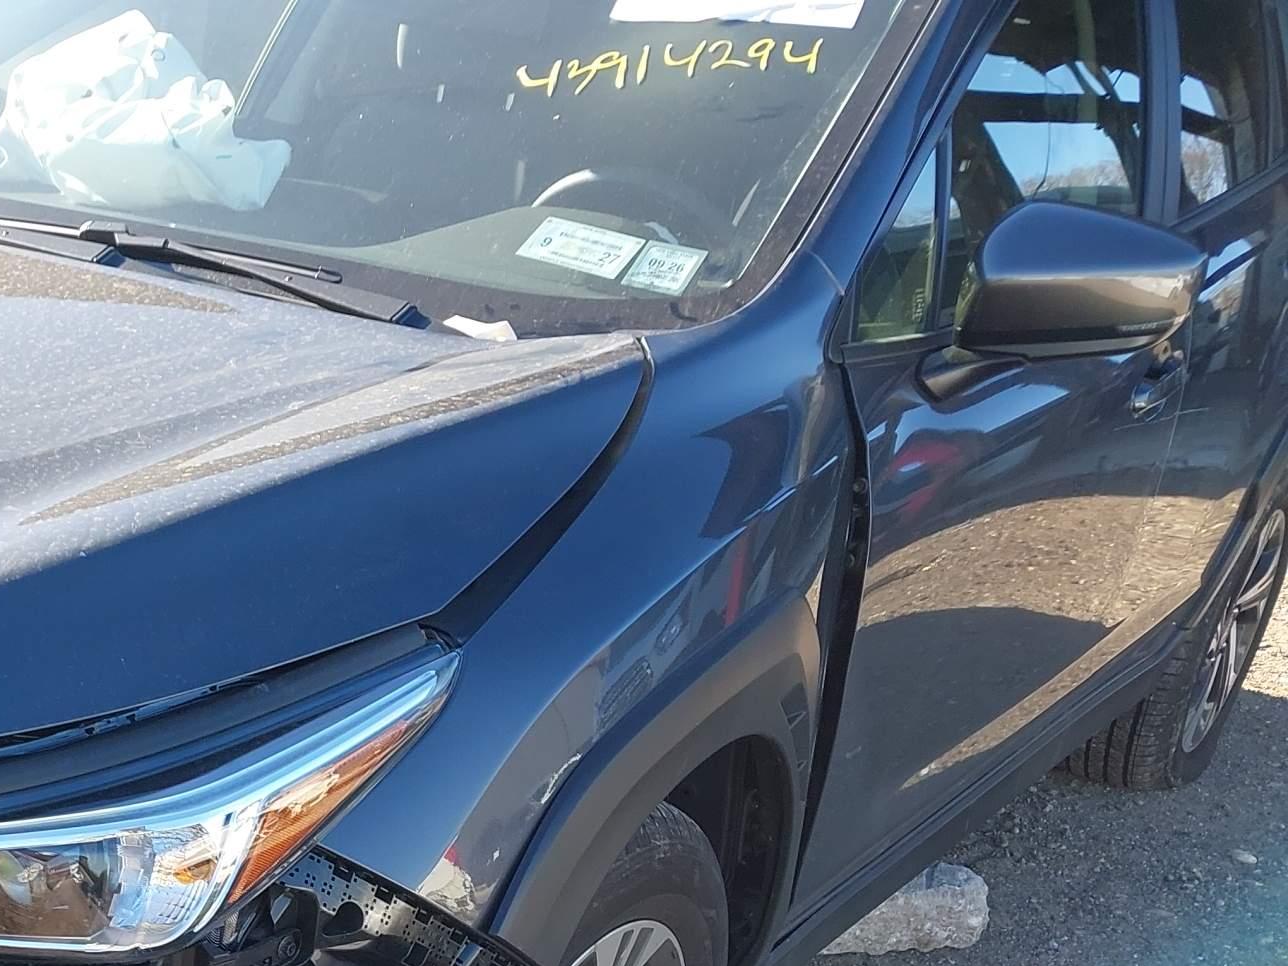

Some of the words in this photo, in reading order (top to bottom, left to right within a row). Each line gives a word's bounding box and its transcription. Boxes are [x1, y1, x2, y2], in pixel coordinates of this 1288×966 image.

[515, 37, 824, 98] 43914294
[540, 236, 554, 248] 9
[598, 250, 622, 265] 27
